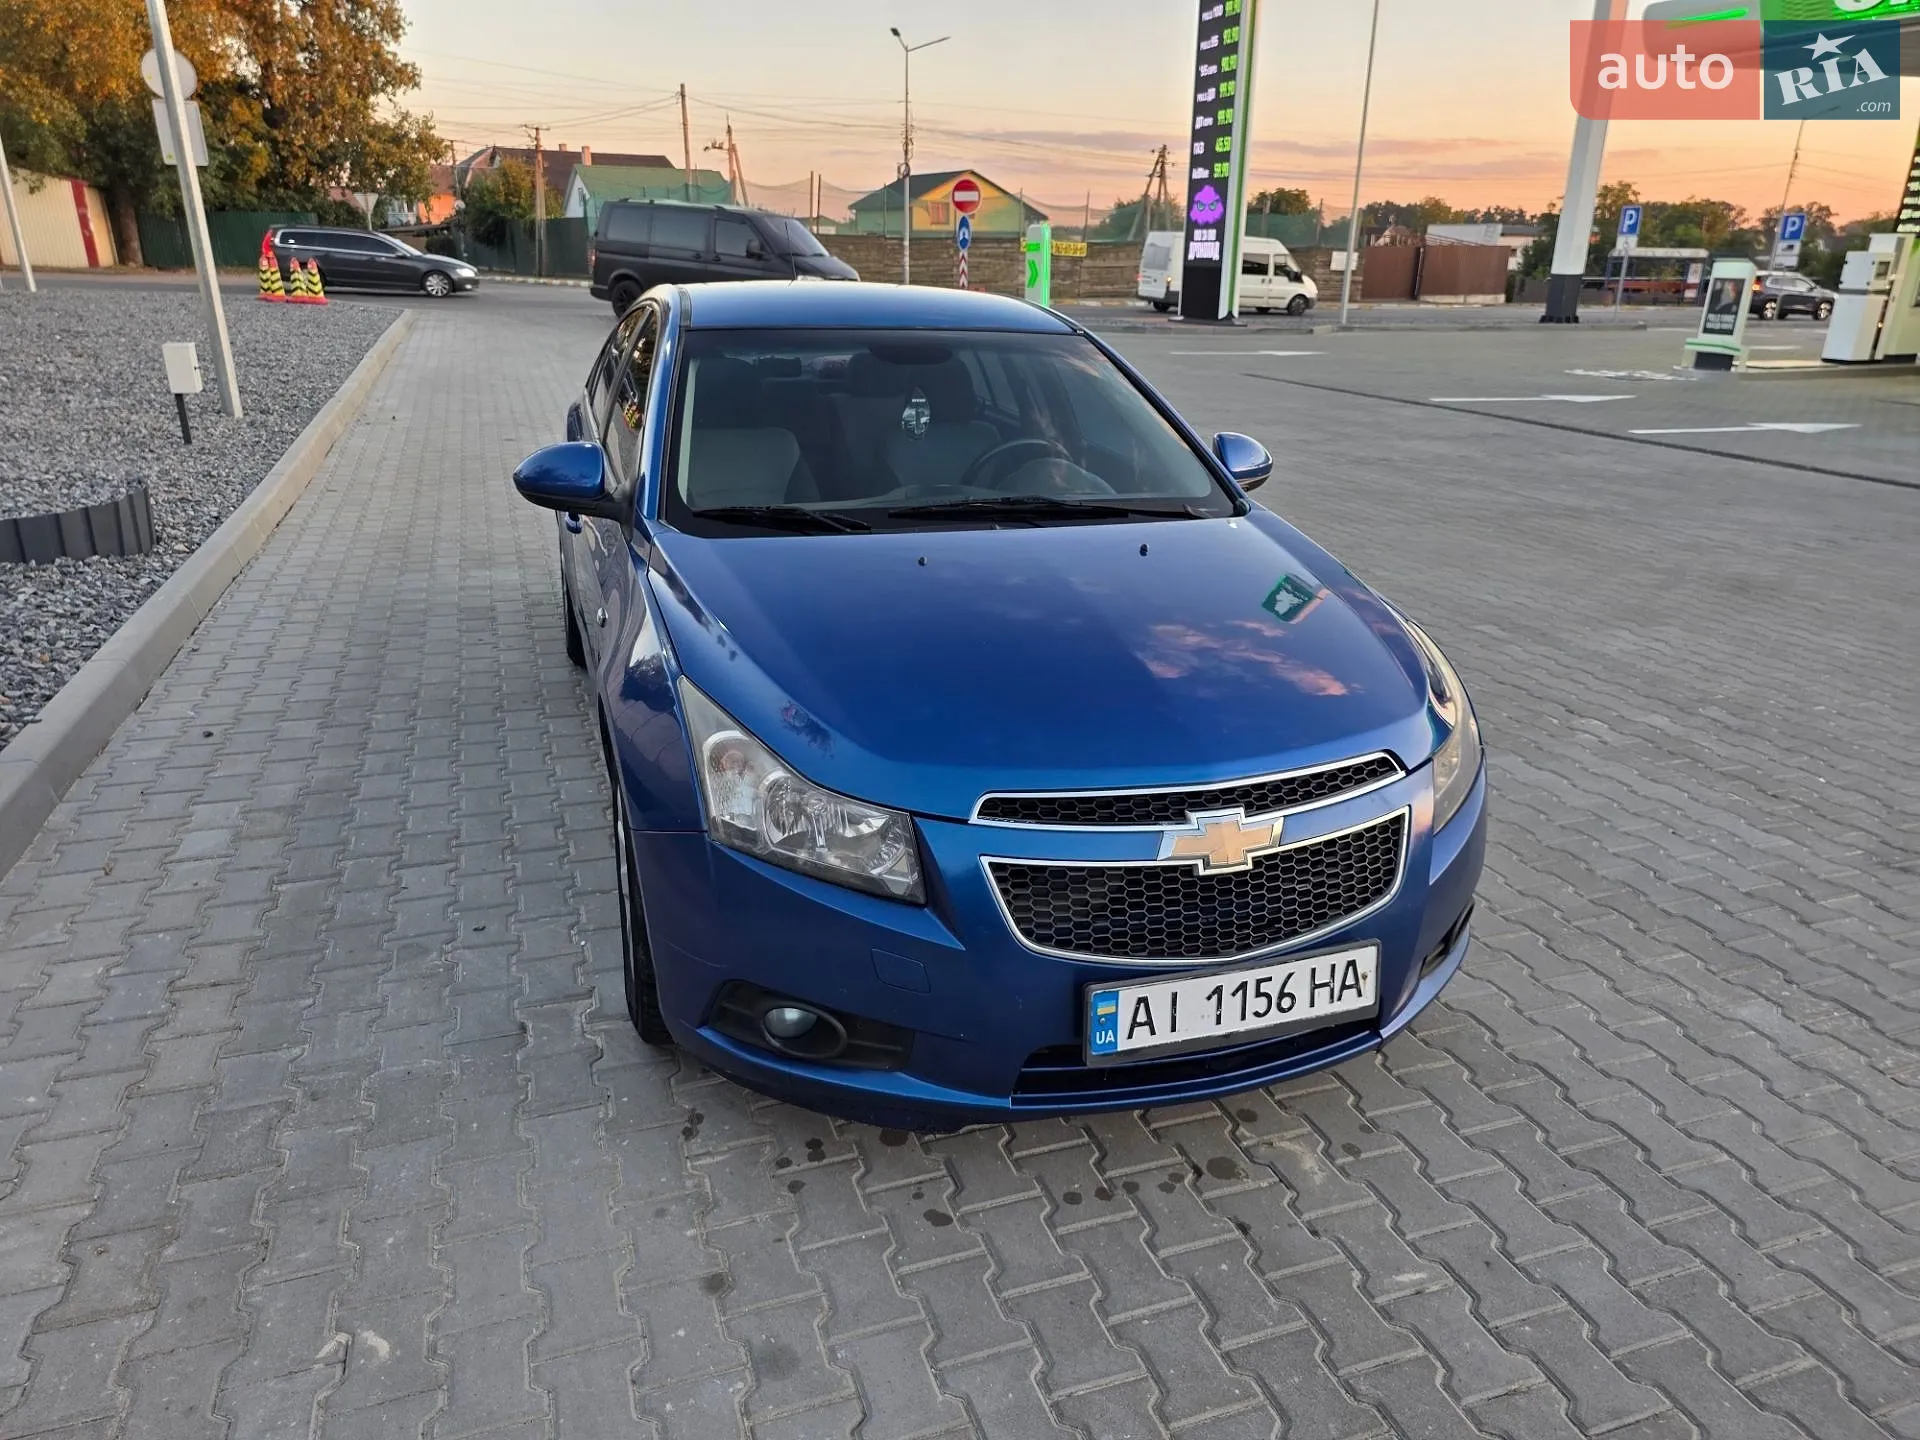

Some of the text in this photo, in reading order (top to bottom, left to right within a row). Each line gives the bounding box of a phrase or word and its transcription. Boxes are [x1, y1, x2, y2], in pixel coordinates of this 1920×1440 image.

[1622, 210, 1637, 232] P
[1785, 217, 1799, 238] P
[1126, 959, 1363, 1040] AI 1156 HA
[1096, 1031, 1115, 1044] UA
